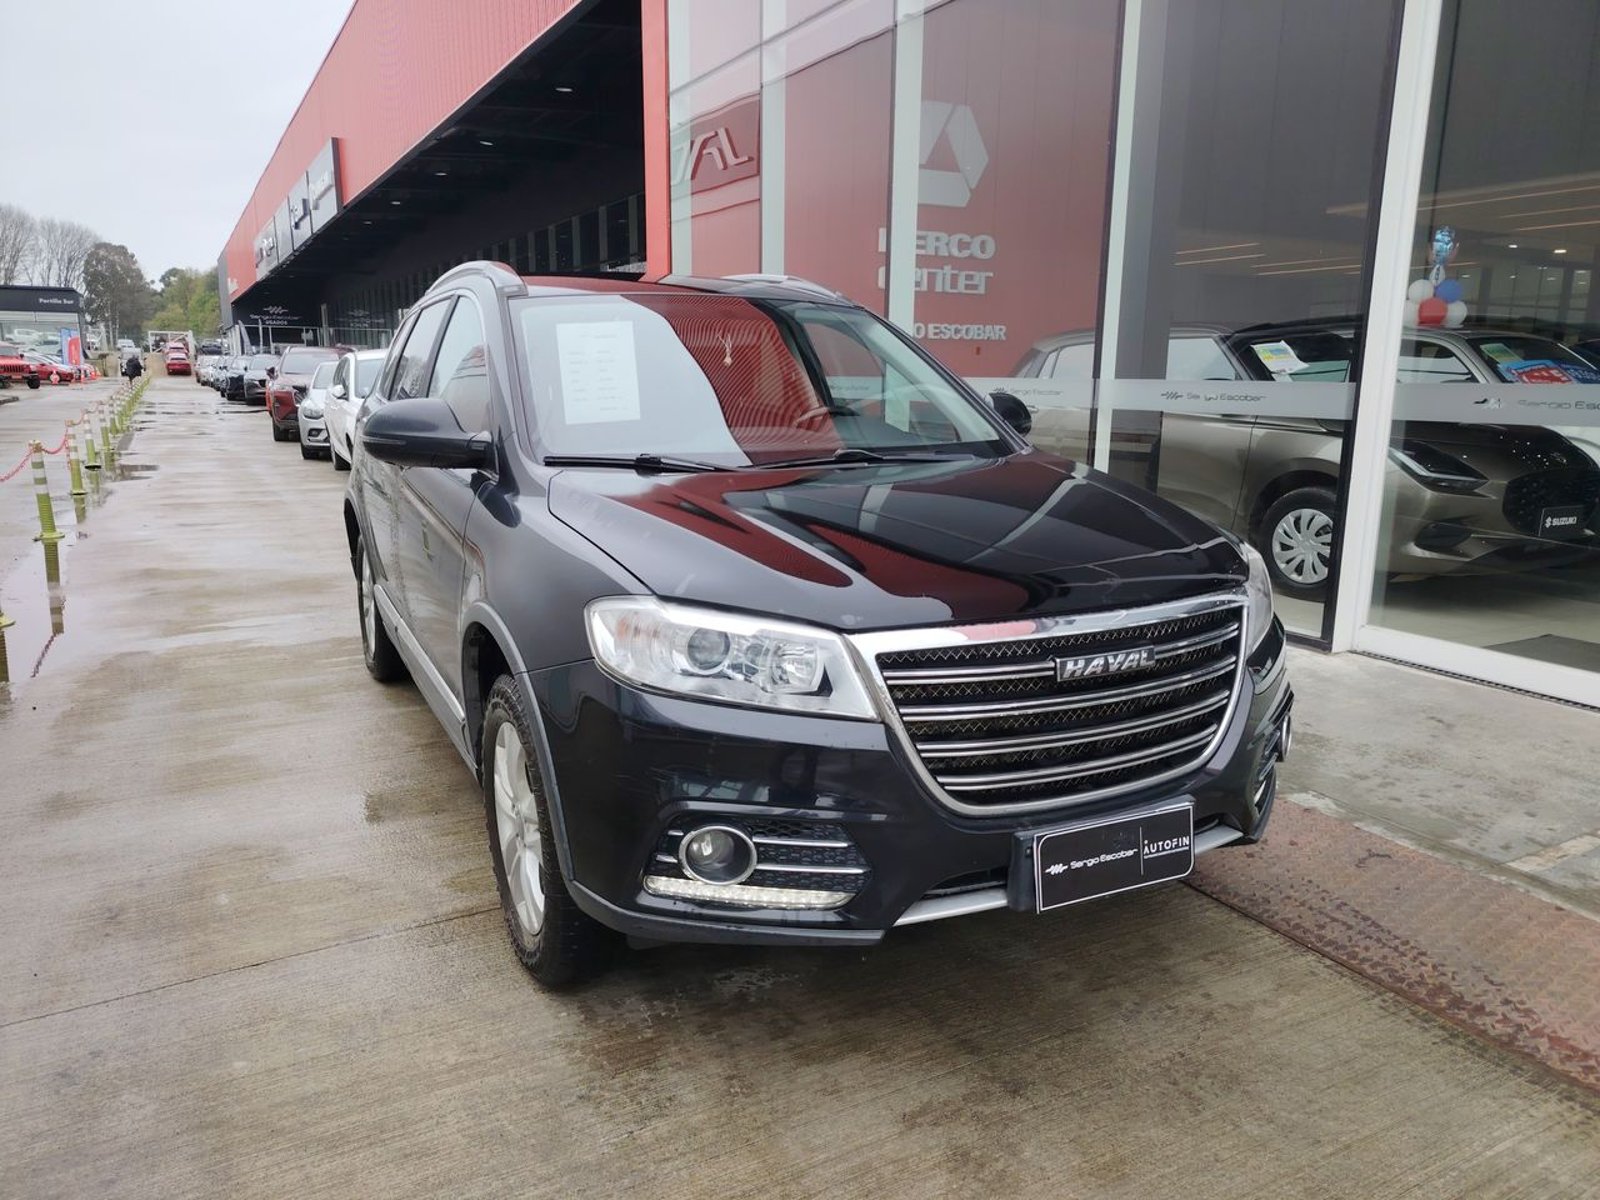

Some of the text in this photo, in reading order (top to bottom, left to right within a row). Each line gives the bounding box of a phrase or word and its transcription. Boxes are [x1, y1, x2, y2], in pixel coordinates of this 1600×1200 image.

[878, 227, 996, 260] ERCO
[927, 323, 1007, 340] ESCOBAR
[1552, 516, 1577, 526] SUZUKI
[1062, 649, 1156, 679] HAVAL
[1100, 848, 1139, 862] Escobar
[1143, 836, 1190, 855] AUTOFIN
